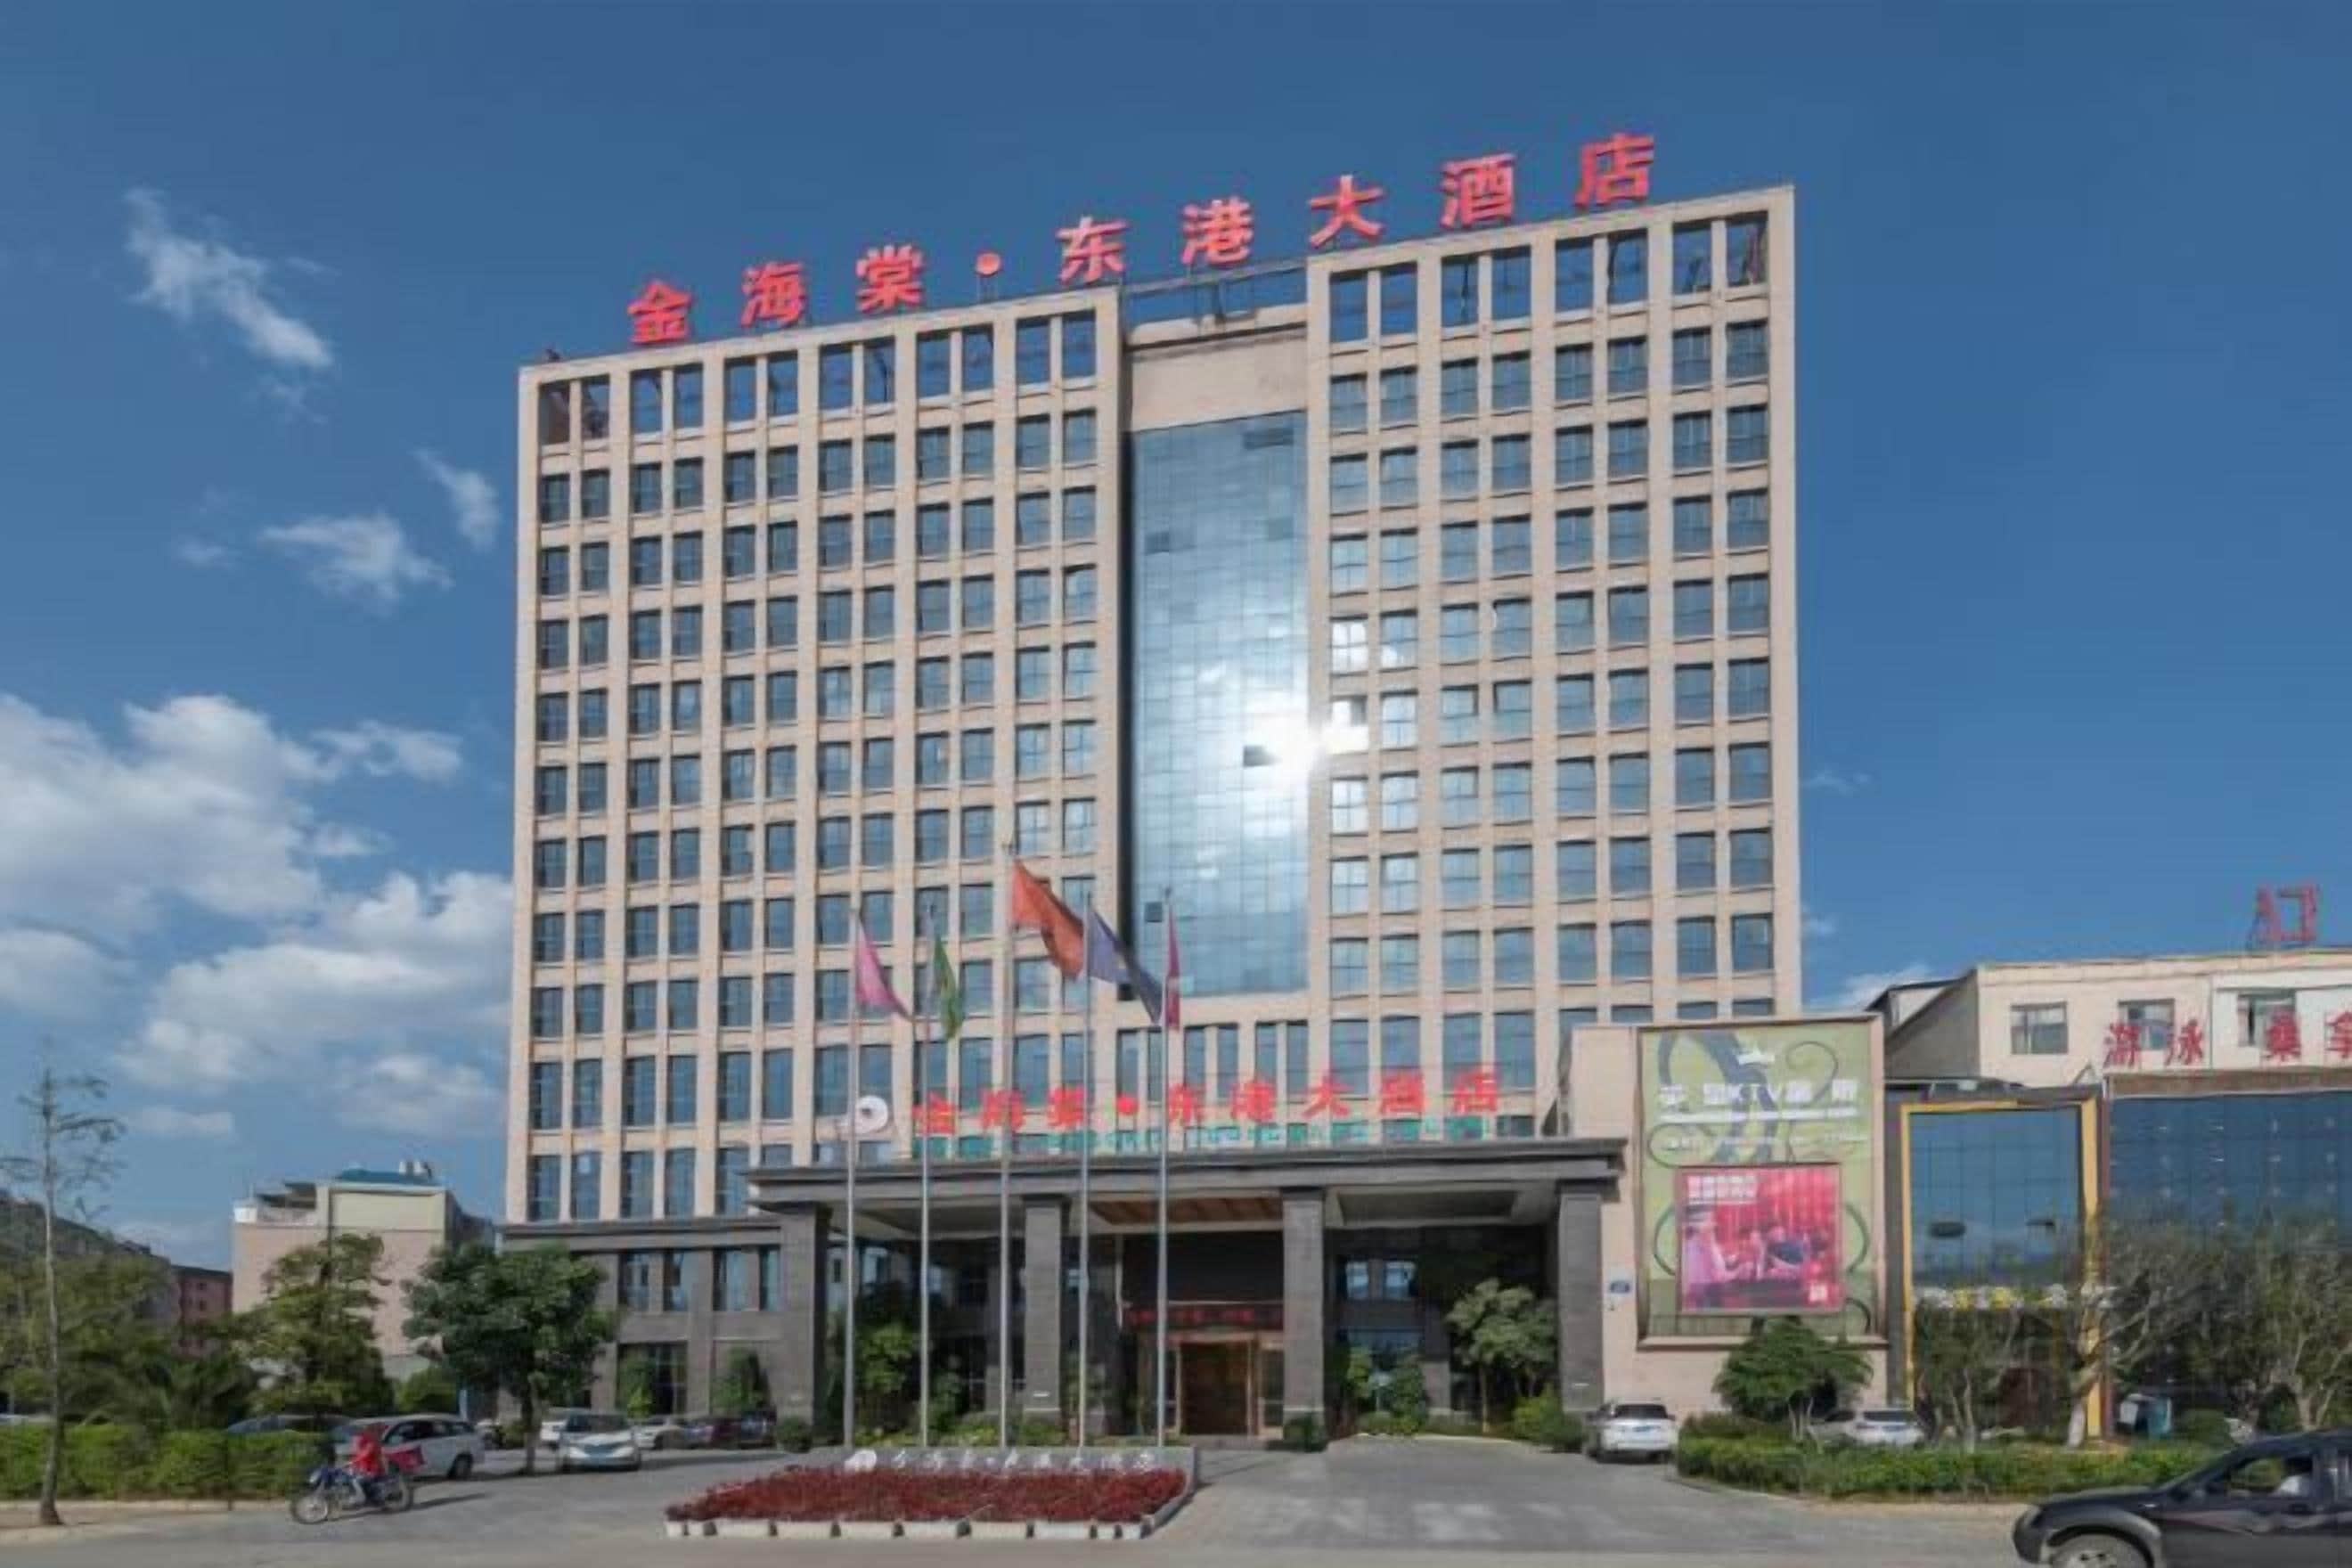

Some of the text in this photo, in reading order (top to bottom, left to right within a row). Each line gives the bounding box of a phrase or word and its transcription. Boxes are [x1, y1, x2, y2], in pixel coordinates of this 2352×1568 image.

[627, 135, 1655, 347] 金海棠·东港大酒店
